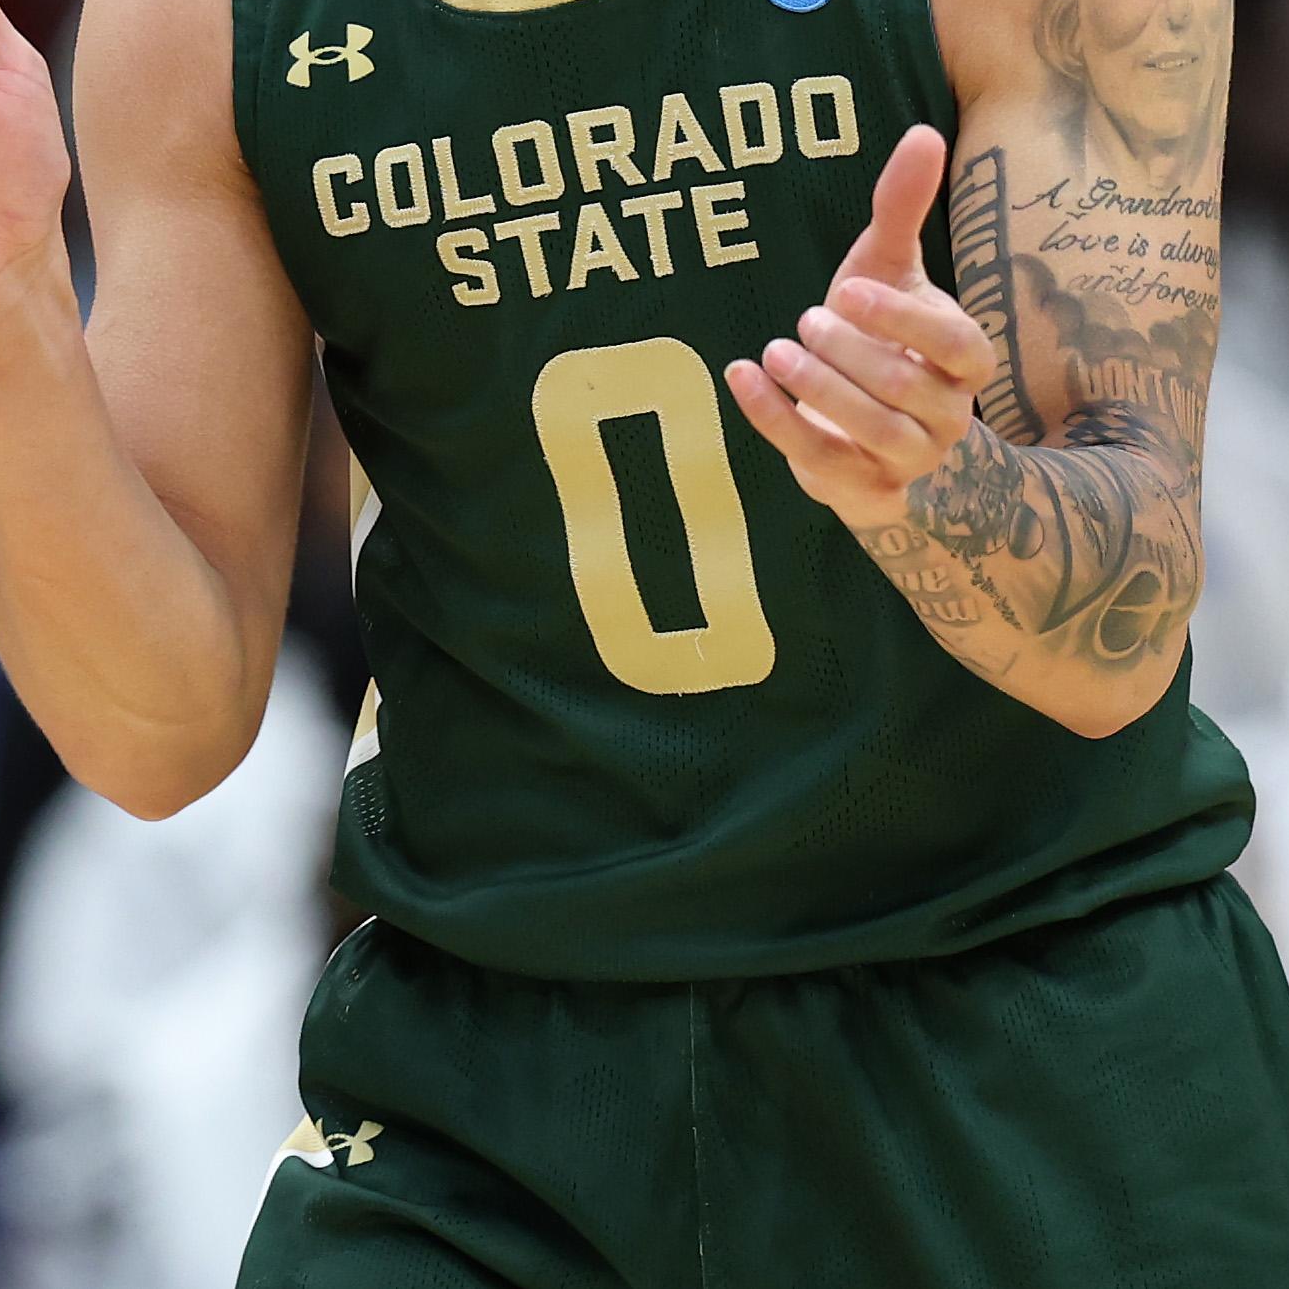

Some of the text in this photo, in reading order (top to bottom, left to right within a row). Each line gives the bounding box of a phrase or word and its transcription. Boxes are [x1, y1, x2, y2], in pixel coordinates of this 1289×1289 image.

[311, 74, 860, 238] COLORADO
[1011, 177, 1071, 211] A
[435, 180, 760, 308] STATE
[1066, 266, 1146, 294] and
[1127, 232, 1150, 258] is
[530, 335, 777, 697] 0
